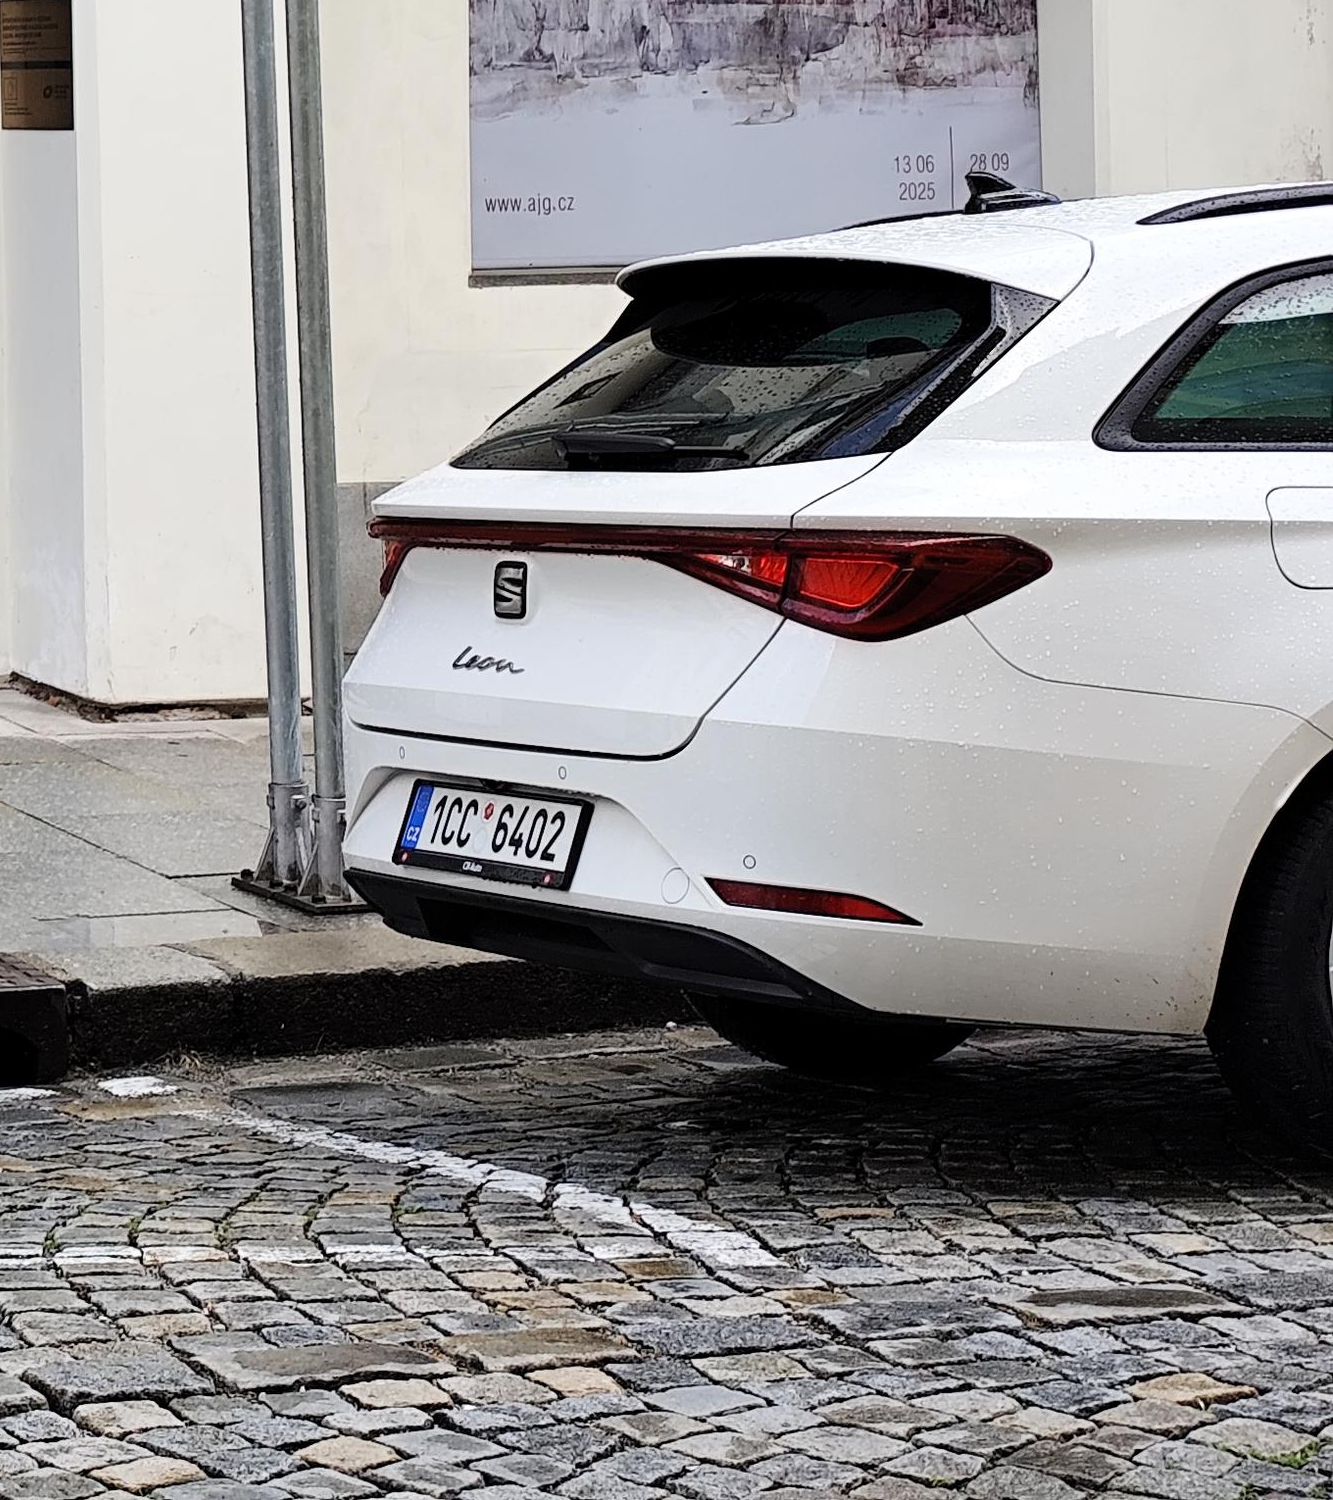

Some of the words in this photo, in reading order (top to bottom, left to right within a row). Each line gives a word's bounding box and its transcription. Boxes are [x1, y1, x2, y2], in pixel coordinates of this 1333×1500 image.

[893, 155, 912, 175] 13
[915, 153, 936, 174] 06
[969, 153, 988, 172] 28
[991, 151, 1010, 172] 09
[898, 181, 936, 202] 2025
[484, 192, 576, 216] www.ajg.cz
[452, 645, 526, 675] Leon
[405, 826, 421, 842] CZ
[430, 794, 479, 848] 1CC
[491, 803, 567, 863] 6402
